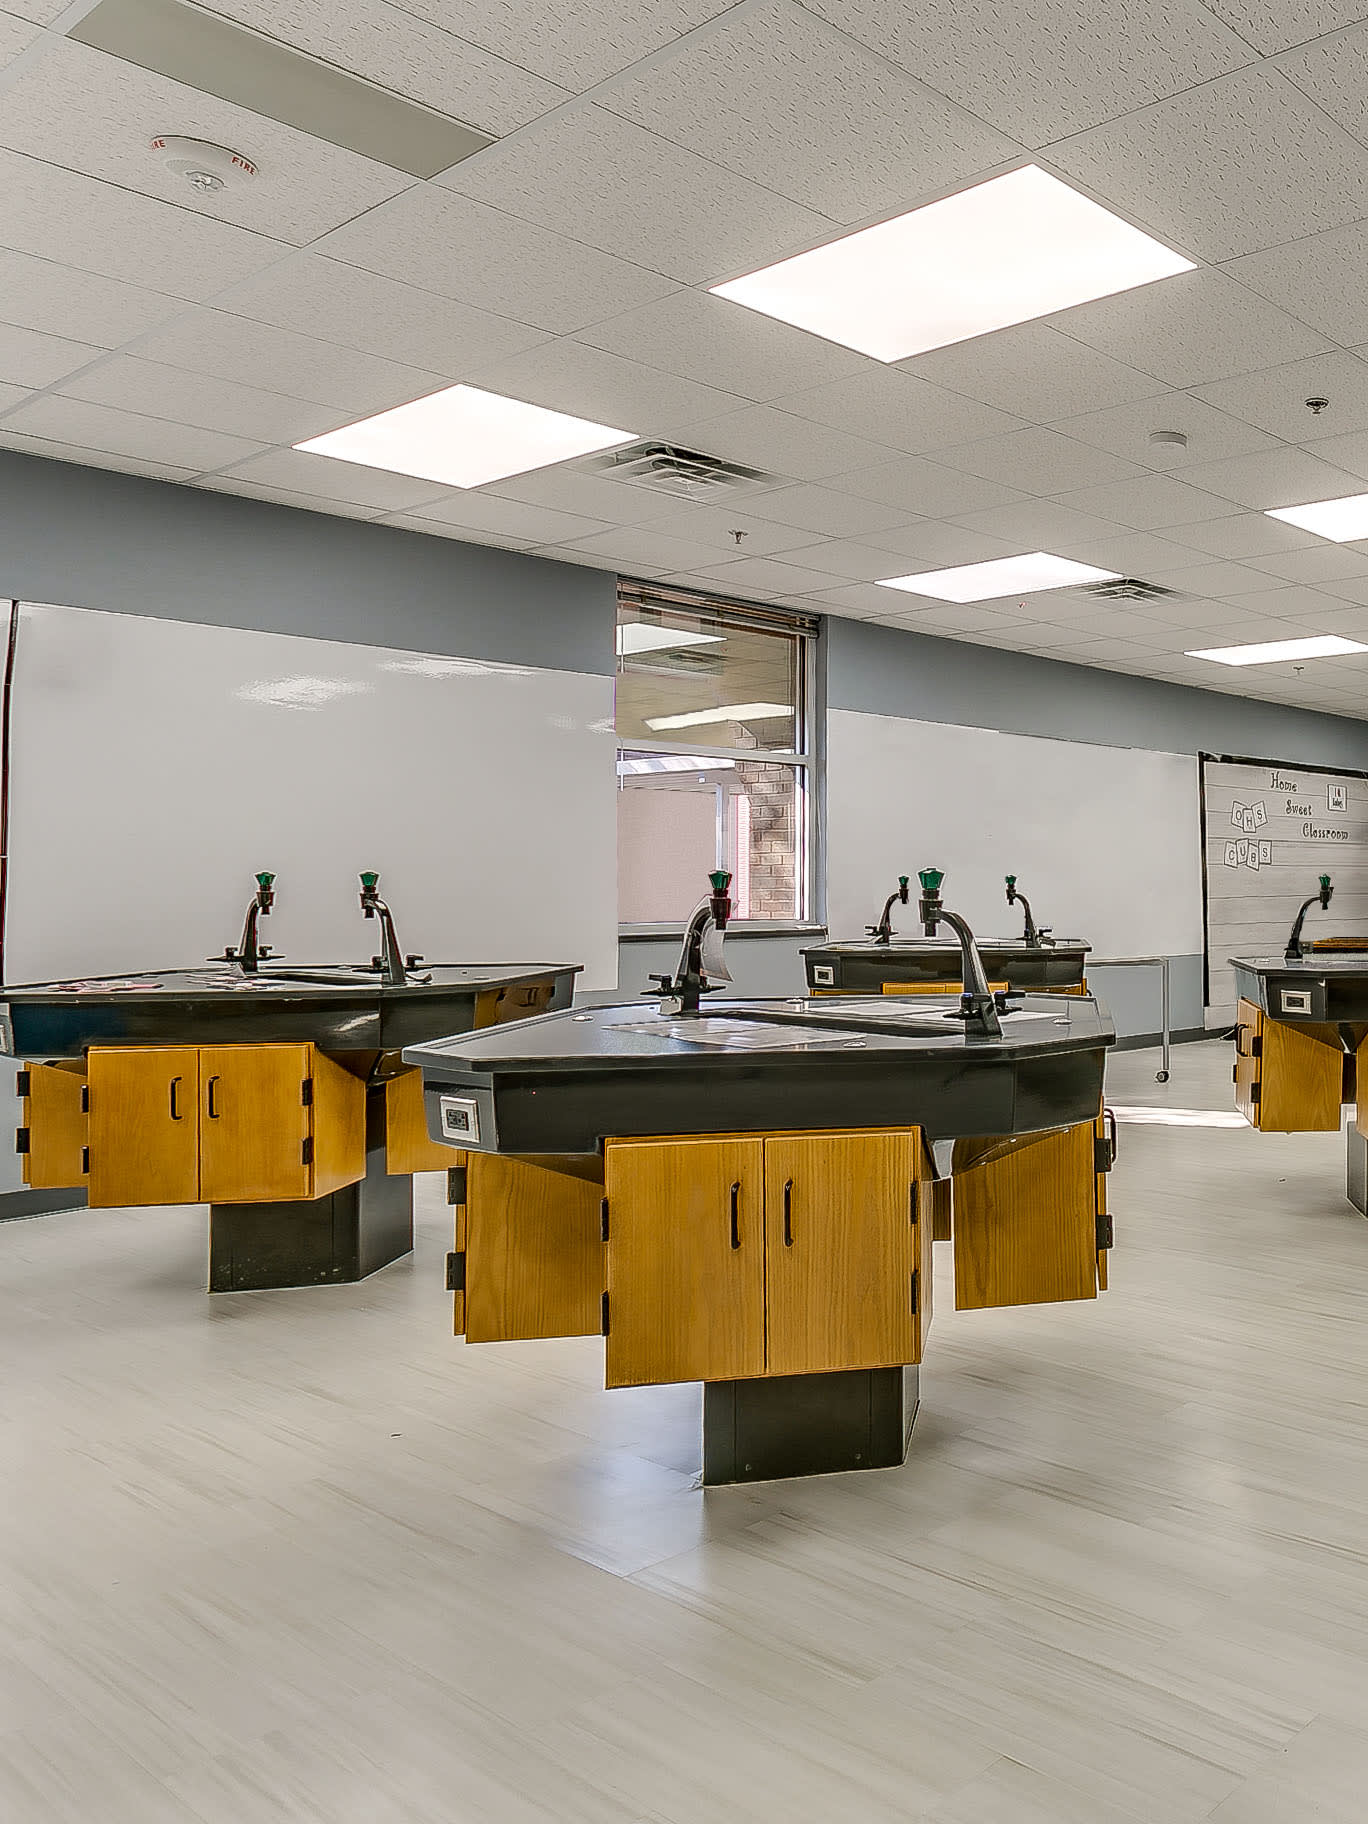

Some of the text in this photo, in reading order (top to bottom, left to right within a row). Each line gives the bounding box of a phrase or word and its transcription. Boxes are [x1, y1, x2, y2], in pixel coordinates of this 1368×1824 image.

[231, 156, 256, 175] FIRE
[1270, 771, 1298, 792] Home
[1286, 799, 1312, 816] Sweet
[1235, 810, 1263, 825] OHS
[1302, 823, 1348, 840] Classroom
[1228, 847, 1268, 862] CUBS
